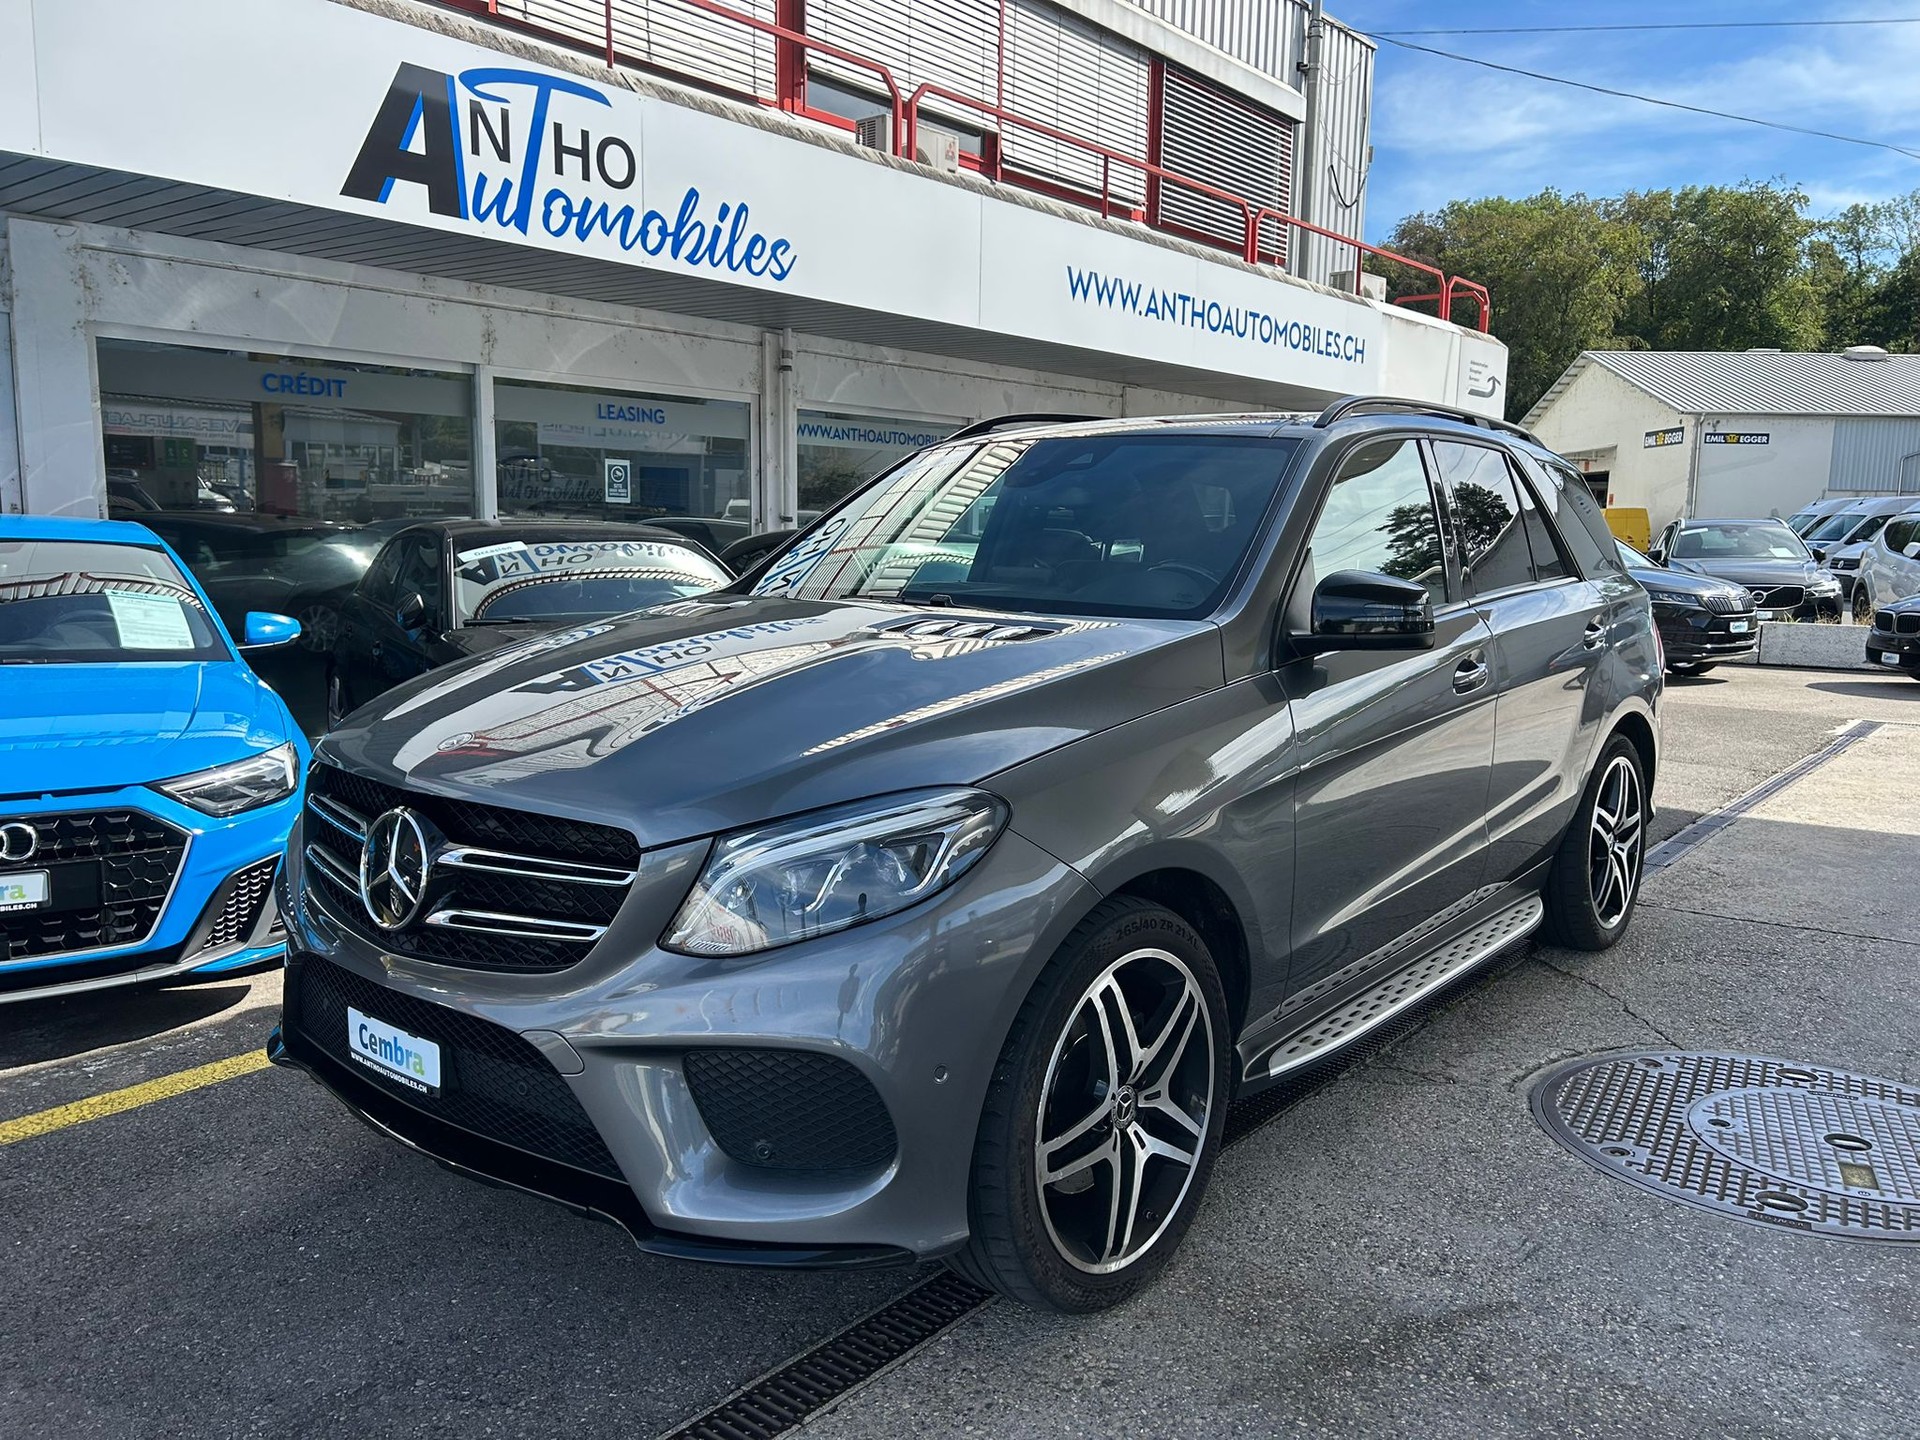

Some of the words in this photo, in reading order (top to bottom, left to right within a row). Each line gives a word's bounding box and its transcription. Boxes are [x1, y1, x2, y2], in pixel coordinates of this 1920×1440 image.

[1066, 265, 1366, 364] WWW.ANTHOAUTOMOBILES.CH
[261, 369, 347, 399] CRÉDIT
[597, 403, 666, 424] LEASING
[1664, 431, 1683, 444] EGGER
[1706, 435, 1725, 443] EMIL
[1740, 435, 1767, 443] EGGER
[1115, 918, 1157, 941] 265/40
[1160, 919, 1174, 932] ZR
[1175, 924, 1186, 938] 21
[358, 1023, 425, 1076] Cembra
